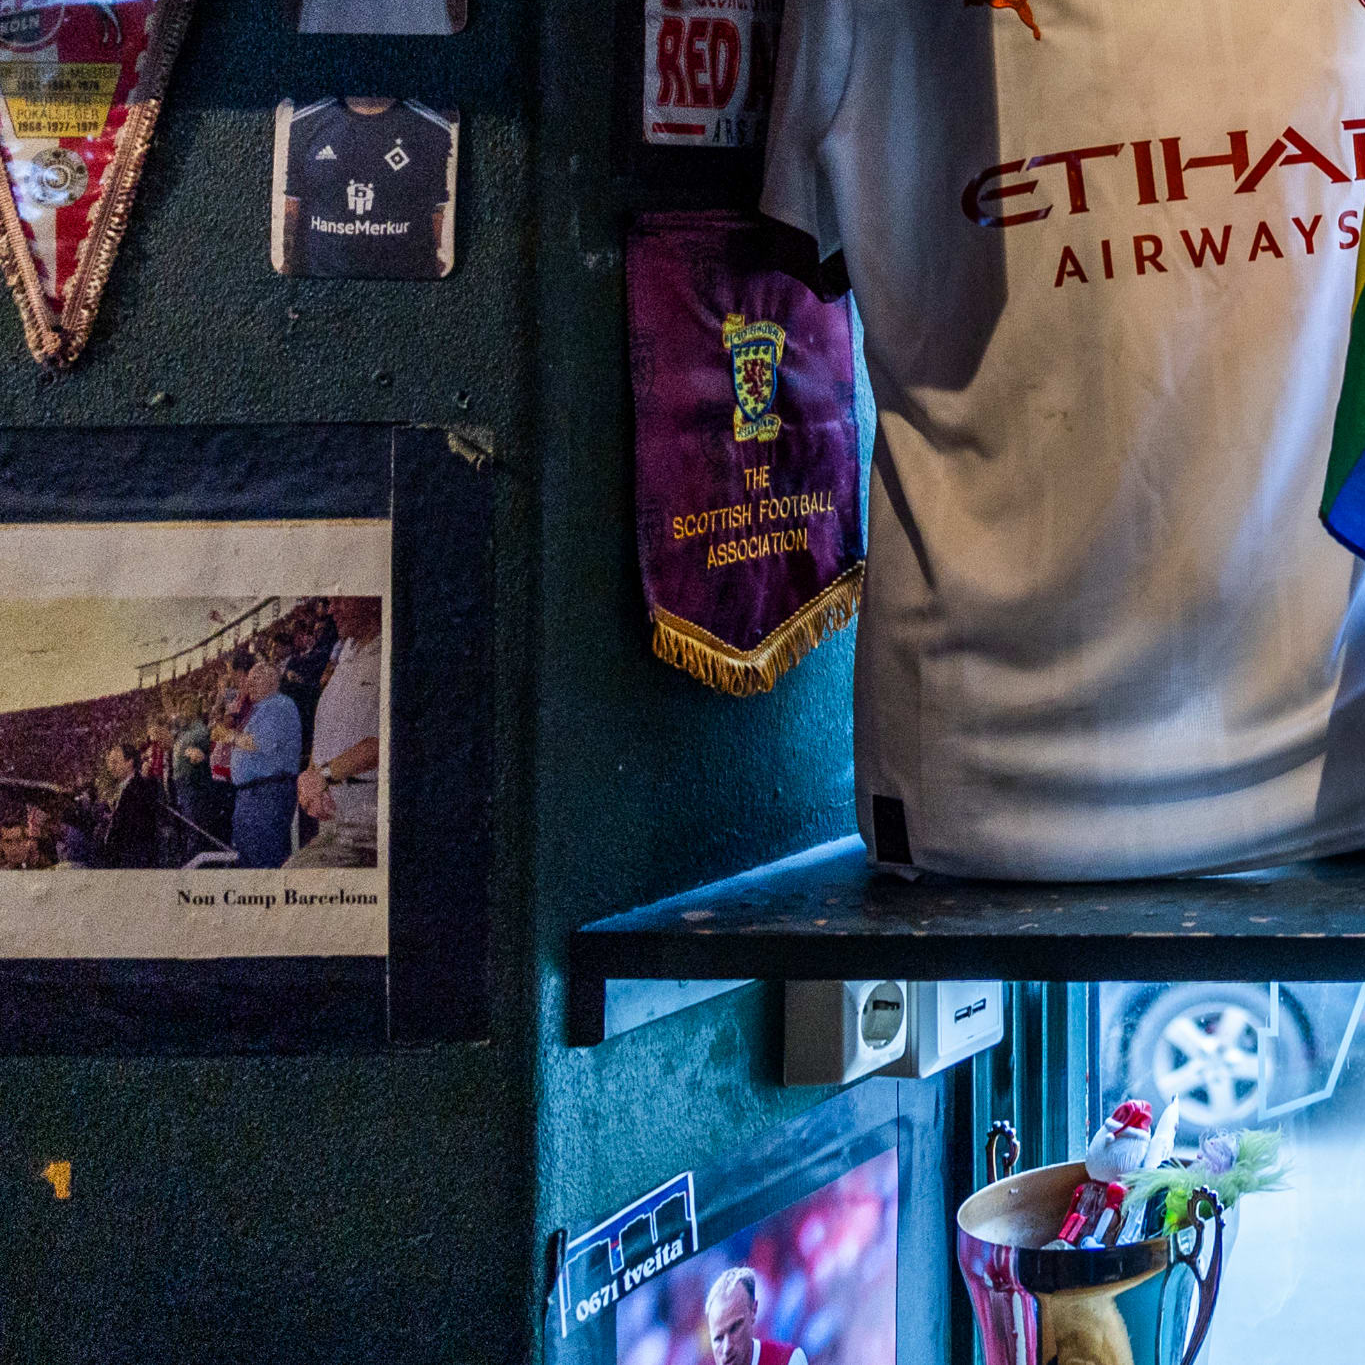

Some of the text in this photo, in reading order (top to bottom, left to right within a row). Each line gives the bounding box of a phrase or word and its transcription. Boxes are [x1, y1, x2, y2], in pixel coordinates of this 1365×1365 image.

[656, 16, 741, 110] RED
[311, 217, 411, 235] HanseMerkur
[1054, 209, 1361, 288] AIRWAYS
[744, 466, 770, 491] THE
[673, 489, 835, 541] SCOTTISH FOOTBALL
[706, 528, 808, 570] ASSOCIATION
[223, 889, 277, 909] Camp
[284, 889, 379, 906] Barcelona
[575, 1238, 685, 1322] 0671 tveita
